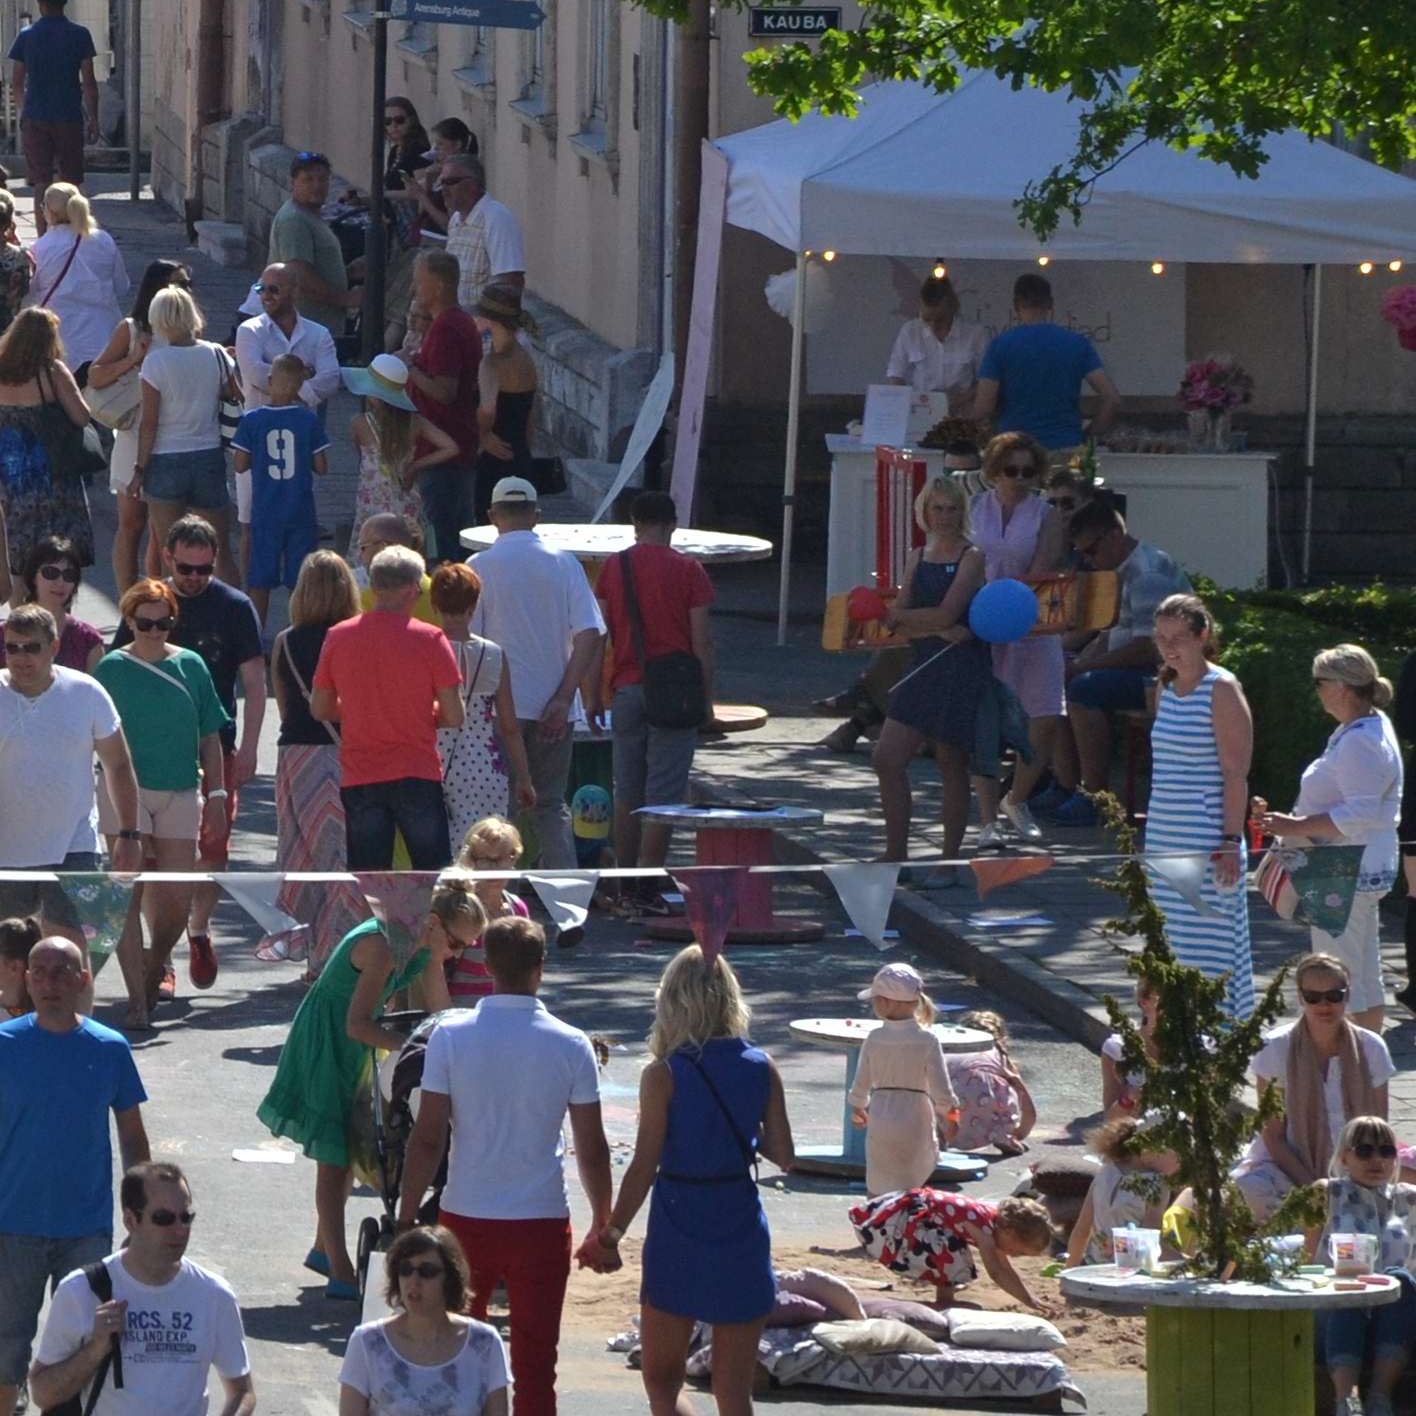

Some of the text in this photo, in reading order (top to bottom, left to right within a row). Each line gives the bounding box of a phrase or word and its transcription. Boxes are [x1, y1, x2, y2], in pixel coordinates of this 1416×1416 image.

[414, 2, 481, 18] Arensburg Antique
[763, 15, 828, 30] KAUBA
[266, 428, 295, 480] 9
[171, 1311, 193, 1331] 52
